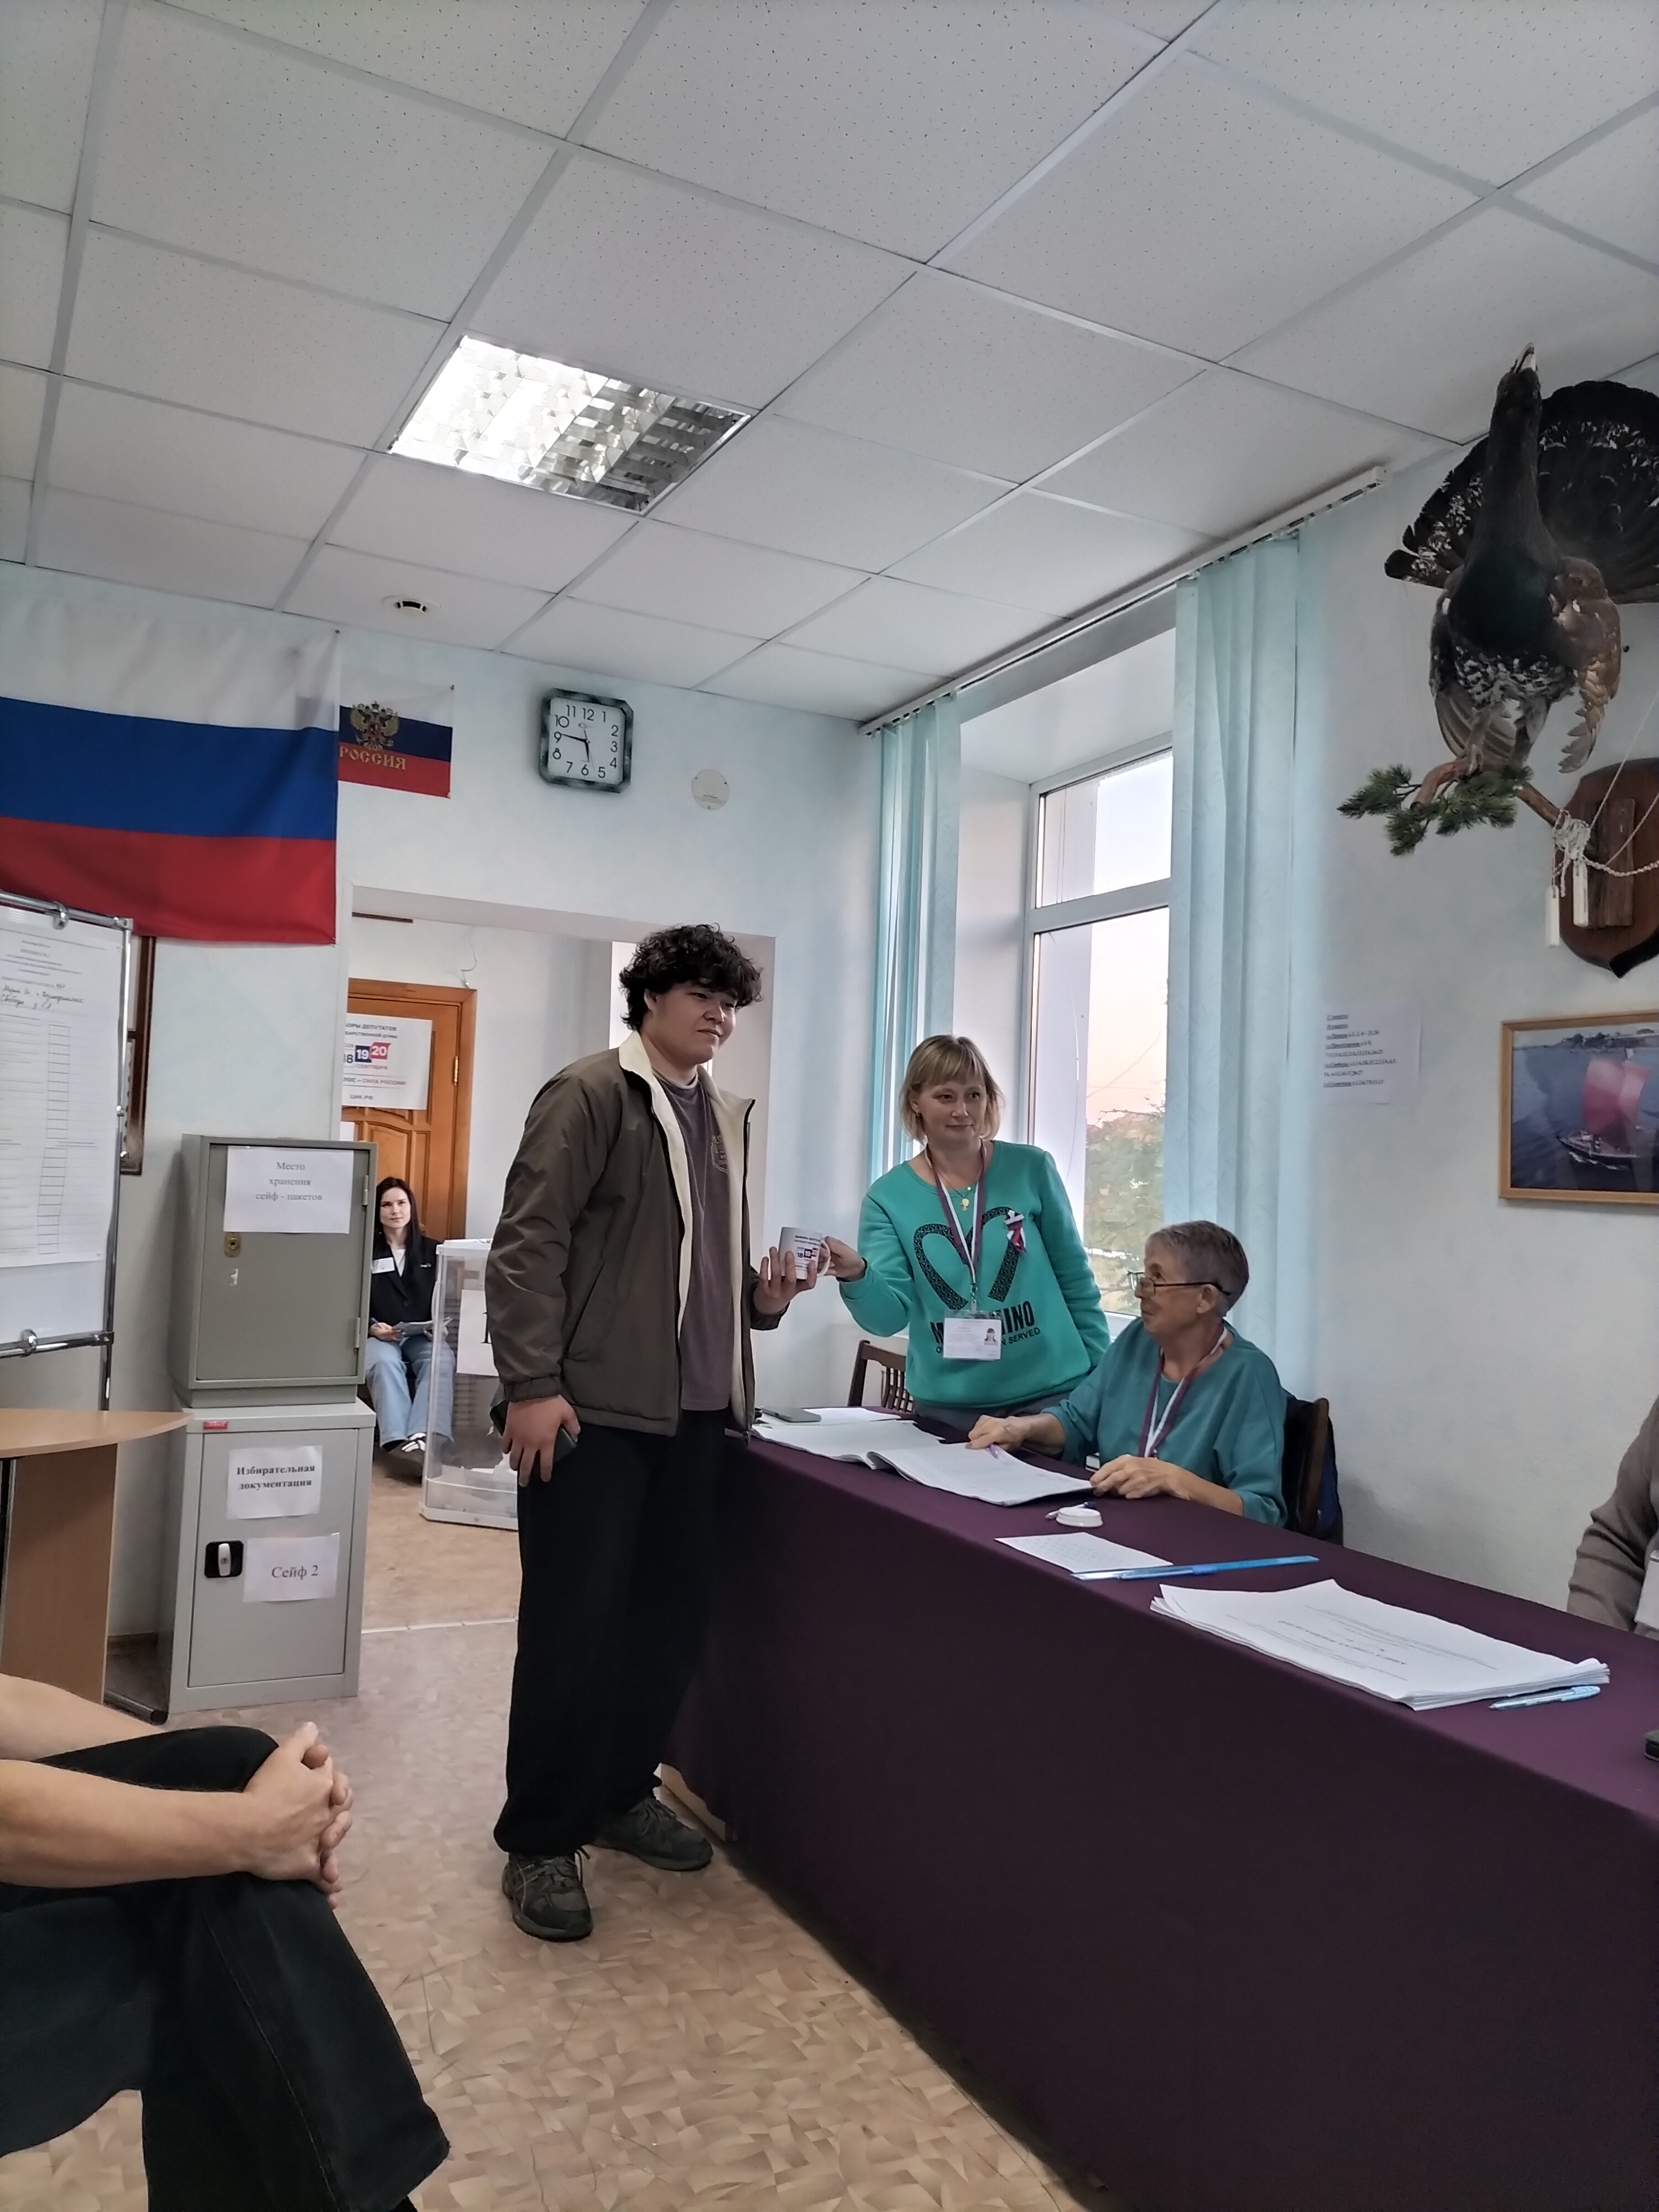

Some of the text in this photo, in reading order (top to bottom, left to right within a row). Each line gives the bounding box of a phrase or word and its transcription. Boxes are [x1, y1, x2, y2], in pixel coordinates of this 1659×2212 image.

[566, 705, 606, 723] 11 12 1
[555, 714, 570, 728] 10
[611, 724, 619, 737] 2
[554, 731, 562, 743] 9
[610, 741, 618, 753] 3
[339, 746, 406, 770] РОССИЯ
[552, 748, 561, 760] 8
[566, 761, 573, 773] 7
[609, 757, 617, 769] 4
[581, 764, 589, 776] 6
[598, 766, 606, 778] 5
[357, 1049, 369, 1060] 19
[371, 1046, 387, 1056] 20
[276, 1162, 305, 1170] Место
[269, 1178, 311, 1187] хранения
[255, 1192, 278, 1202] сейф
[1009, 1327, 1040, 1344] SERVED
[237, 1465, 315, 1476] Избирательная
[238, 1479, 312, 1490] документация
[271, 1565, 319, 1580] Сейф 2
